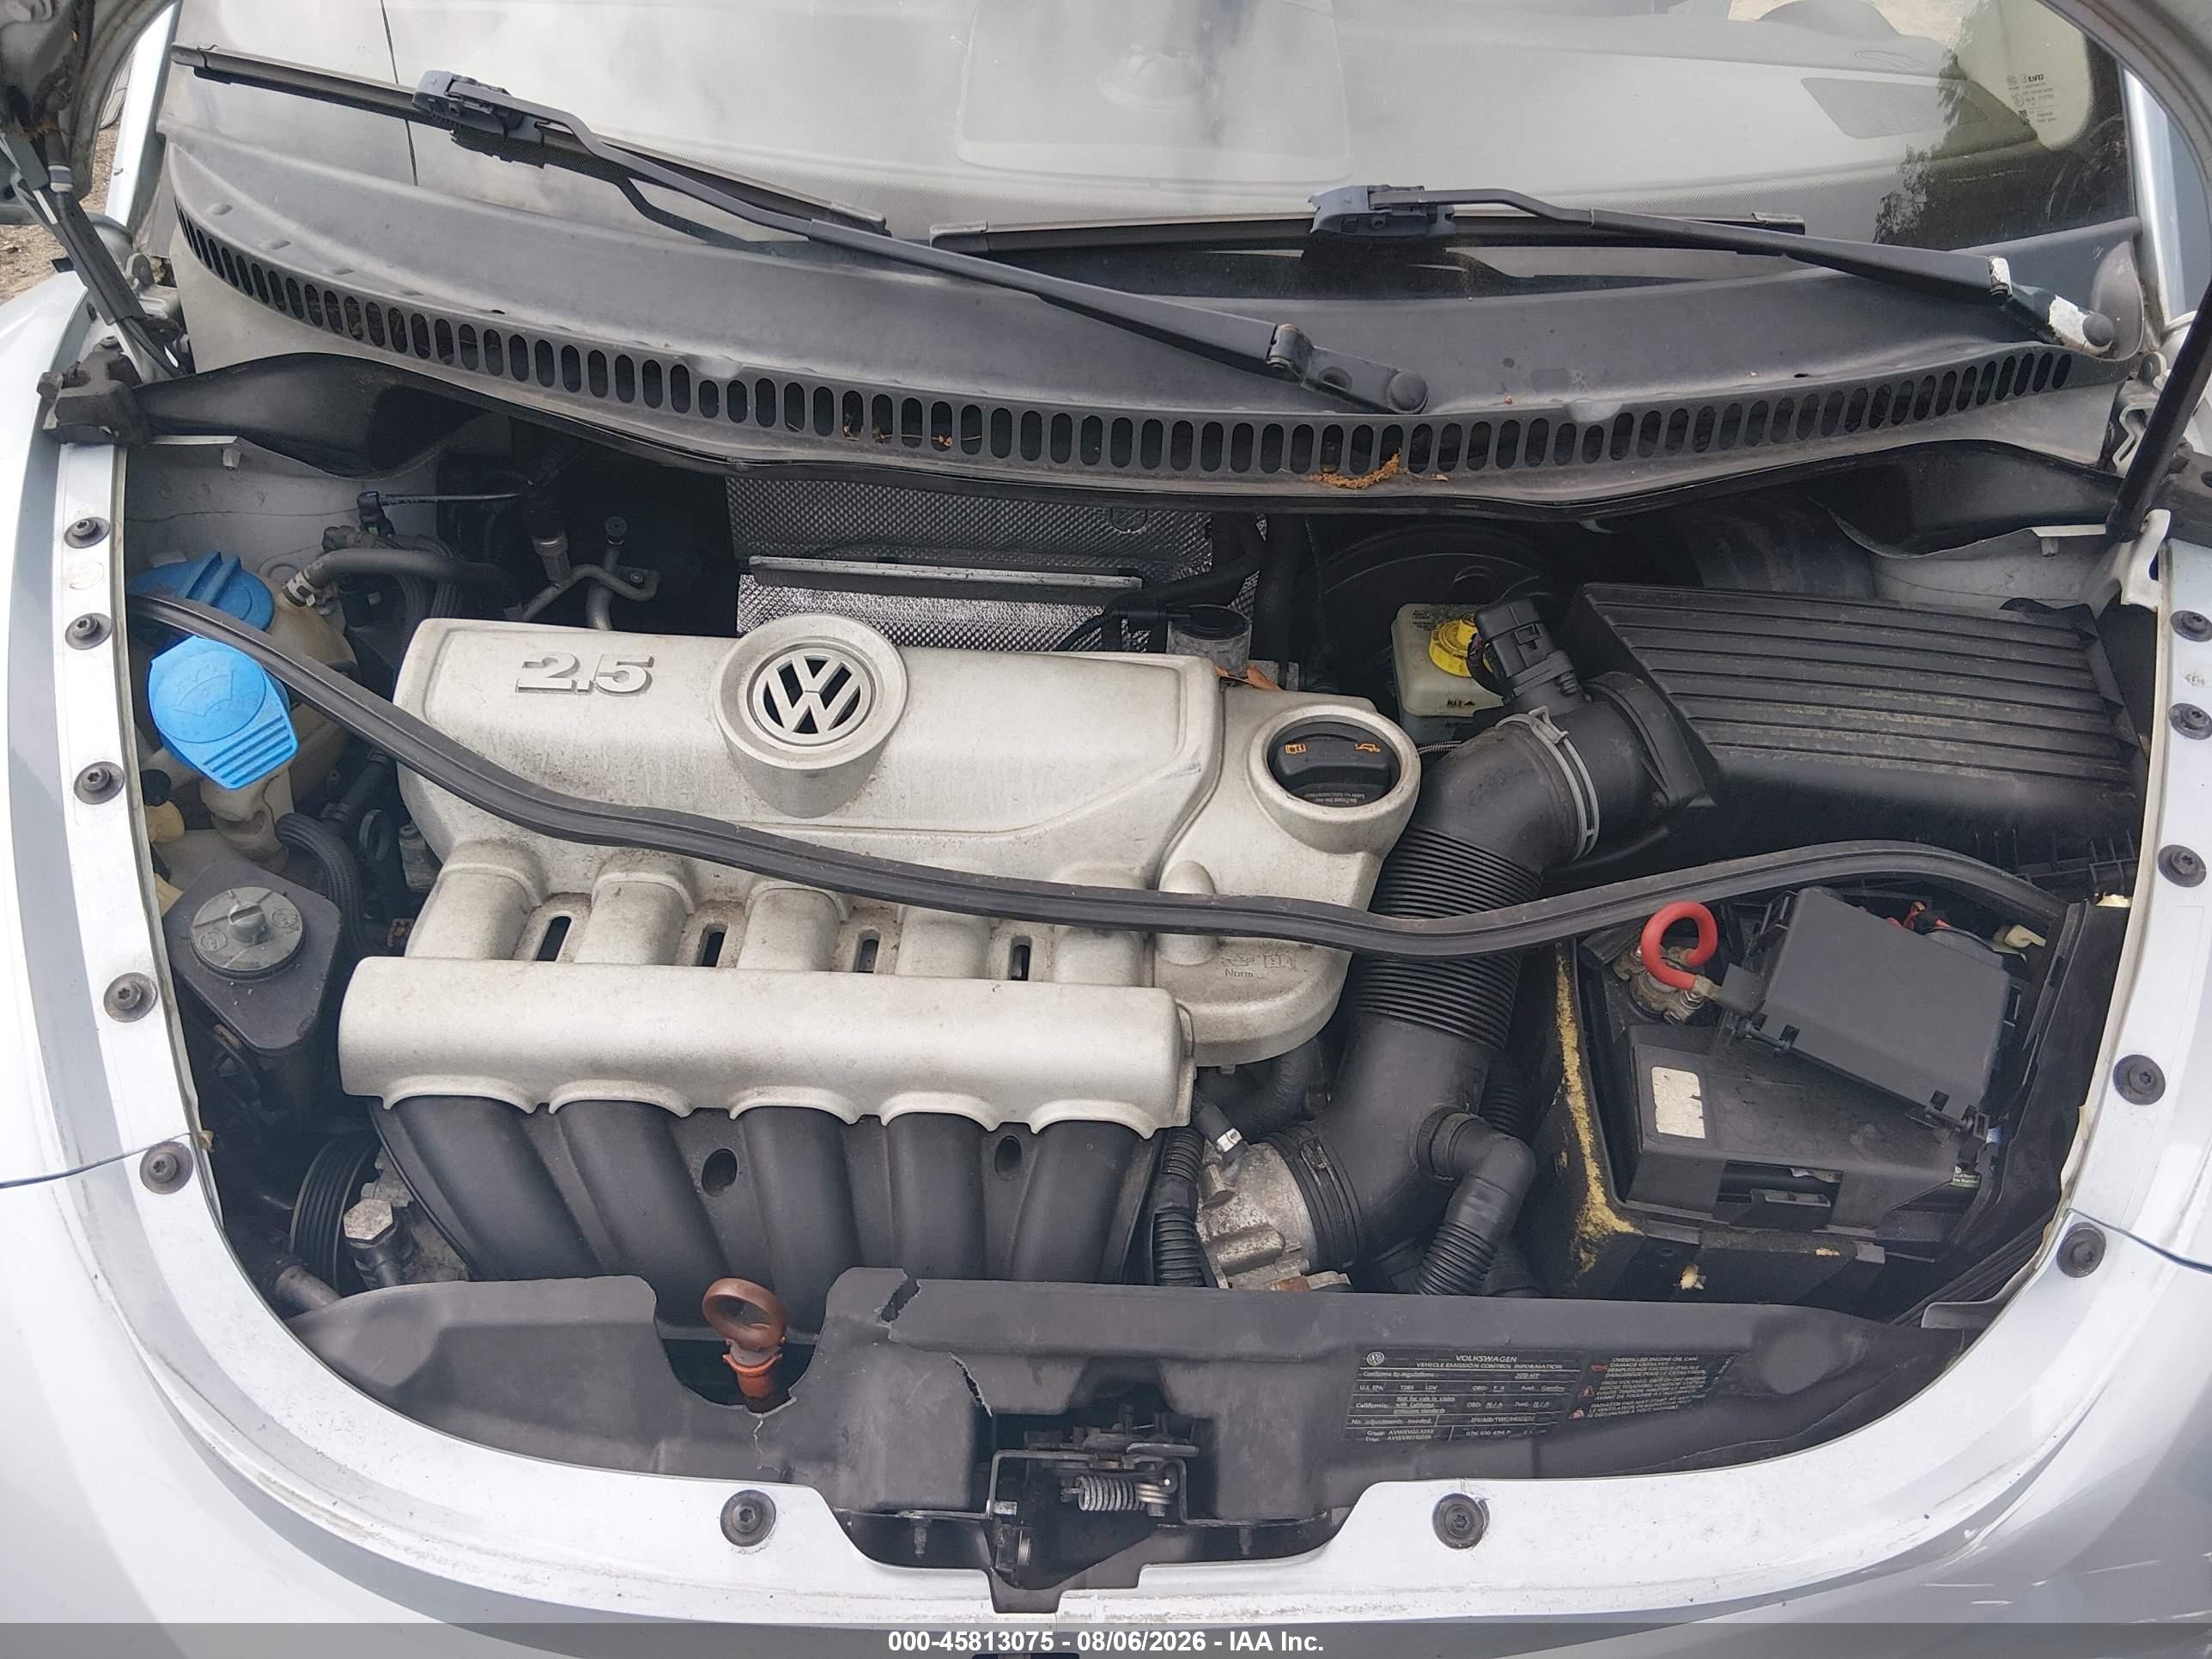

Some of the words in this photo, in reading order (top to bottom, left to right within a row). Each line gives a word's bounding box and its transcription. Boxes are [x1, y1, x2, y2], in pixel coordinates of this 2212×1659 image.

[515, 650, 654, 695] 2.5
[1446, 699, 1463, 708] MAX
[1224, 968, 1255, 980] Norm
[1455, 1354, 1517, 1363] VOLKSWAGEN
